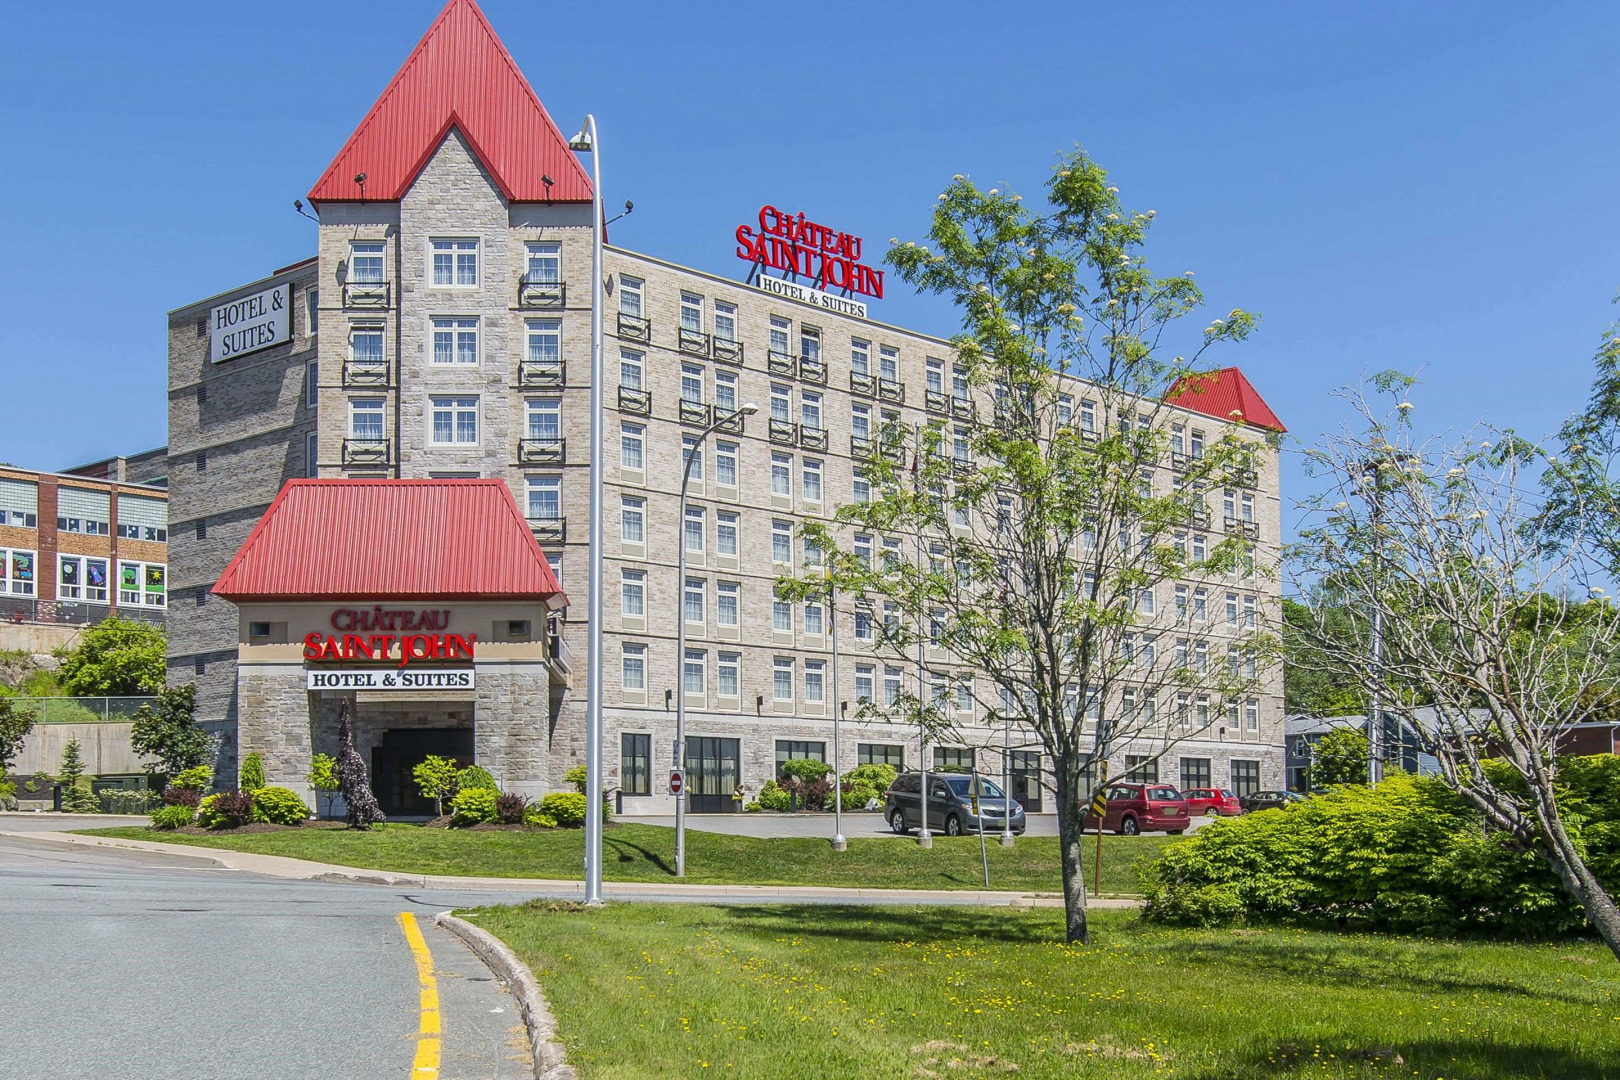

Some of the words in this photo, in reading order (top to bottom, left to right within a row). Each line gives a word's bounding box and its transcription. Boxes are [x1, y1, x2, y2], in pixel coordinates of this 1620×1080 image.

[758, 204, 862, 261] CHÂTEAU
[735, 224, 817, 279] SAINT
[818, 252, 885, 300] JOHN
[216, 295, 267, 330] HOTEL
[272, 290, 284, 312] &
[762, 277, 806, 302] HOTEL
[809, 291, 819, 305] &
[821, 295, 865, 318] SUITES
[222, 320, 275, 356] SUITES
[330, 605, 451, 632] CHÂTEAU
[302, 632, 396, 660] SAINT
[398, 633, 477, 668] JOHN
[312, 673, 377, 687] HOTEL
[382, 673, 397, 687] &
[401, 673, 470, 687] SUITES
